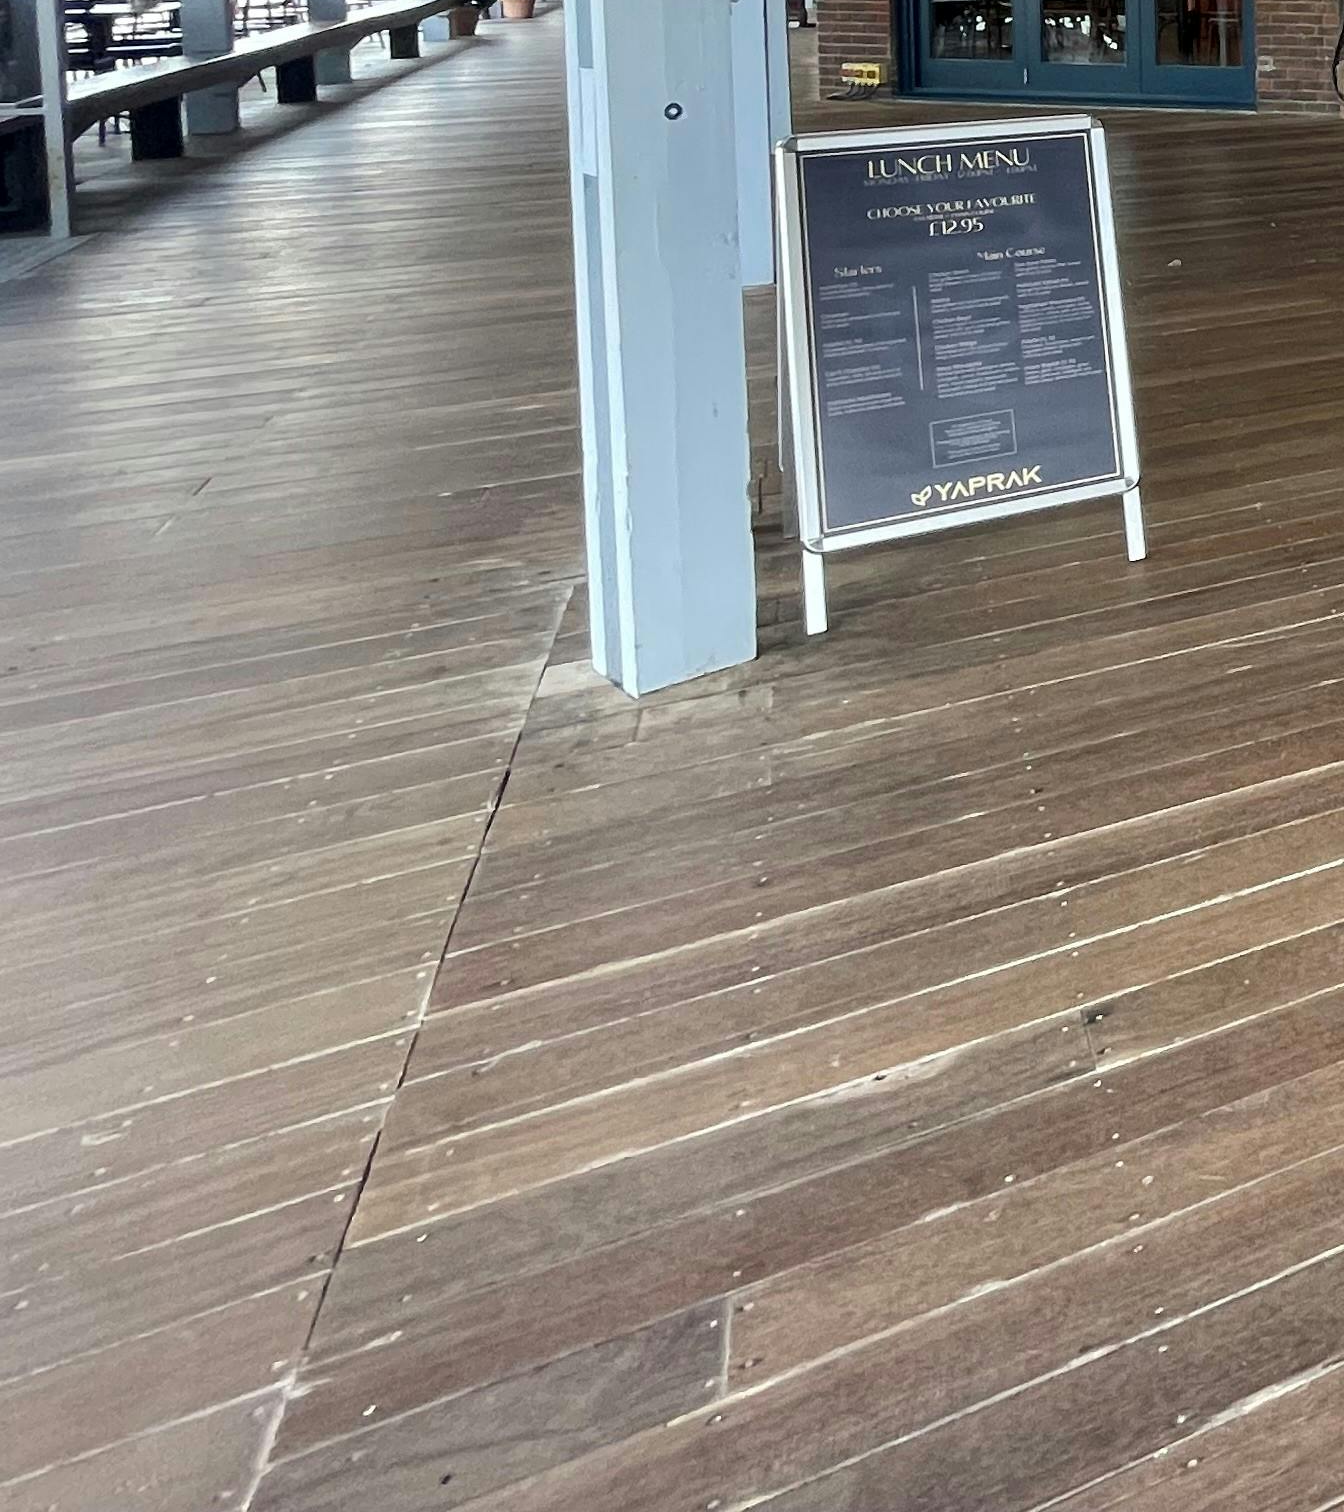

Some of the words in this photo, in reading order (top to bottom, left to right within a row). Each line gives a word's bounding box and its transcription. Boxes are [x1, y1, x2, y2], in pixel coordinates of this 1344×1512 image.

[867, 152, 952, 179] LUNCH
[959, 147, 1031, 169] MENU
[866, 203, 925, 220] CHOOSE
[926, 199, 964, 215] YOUR
[934, 464, 1042, 501] YAPRAK
